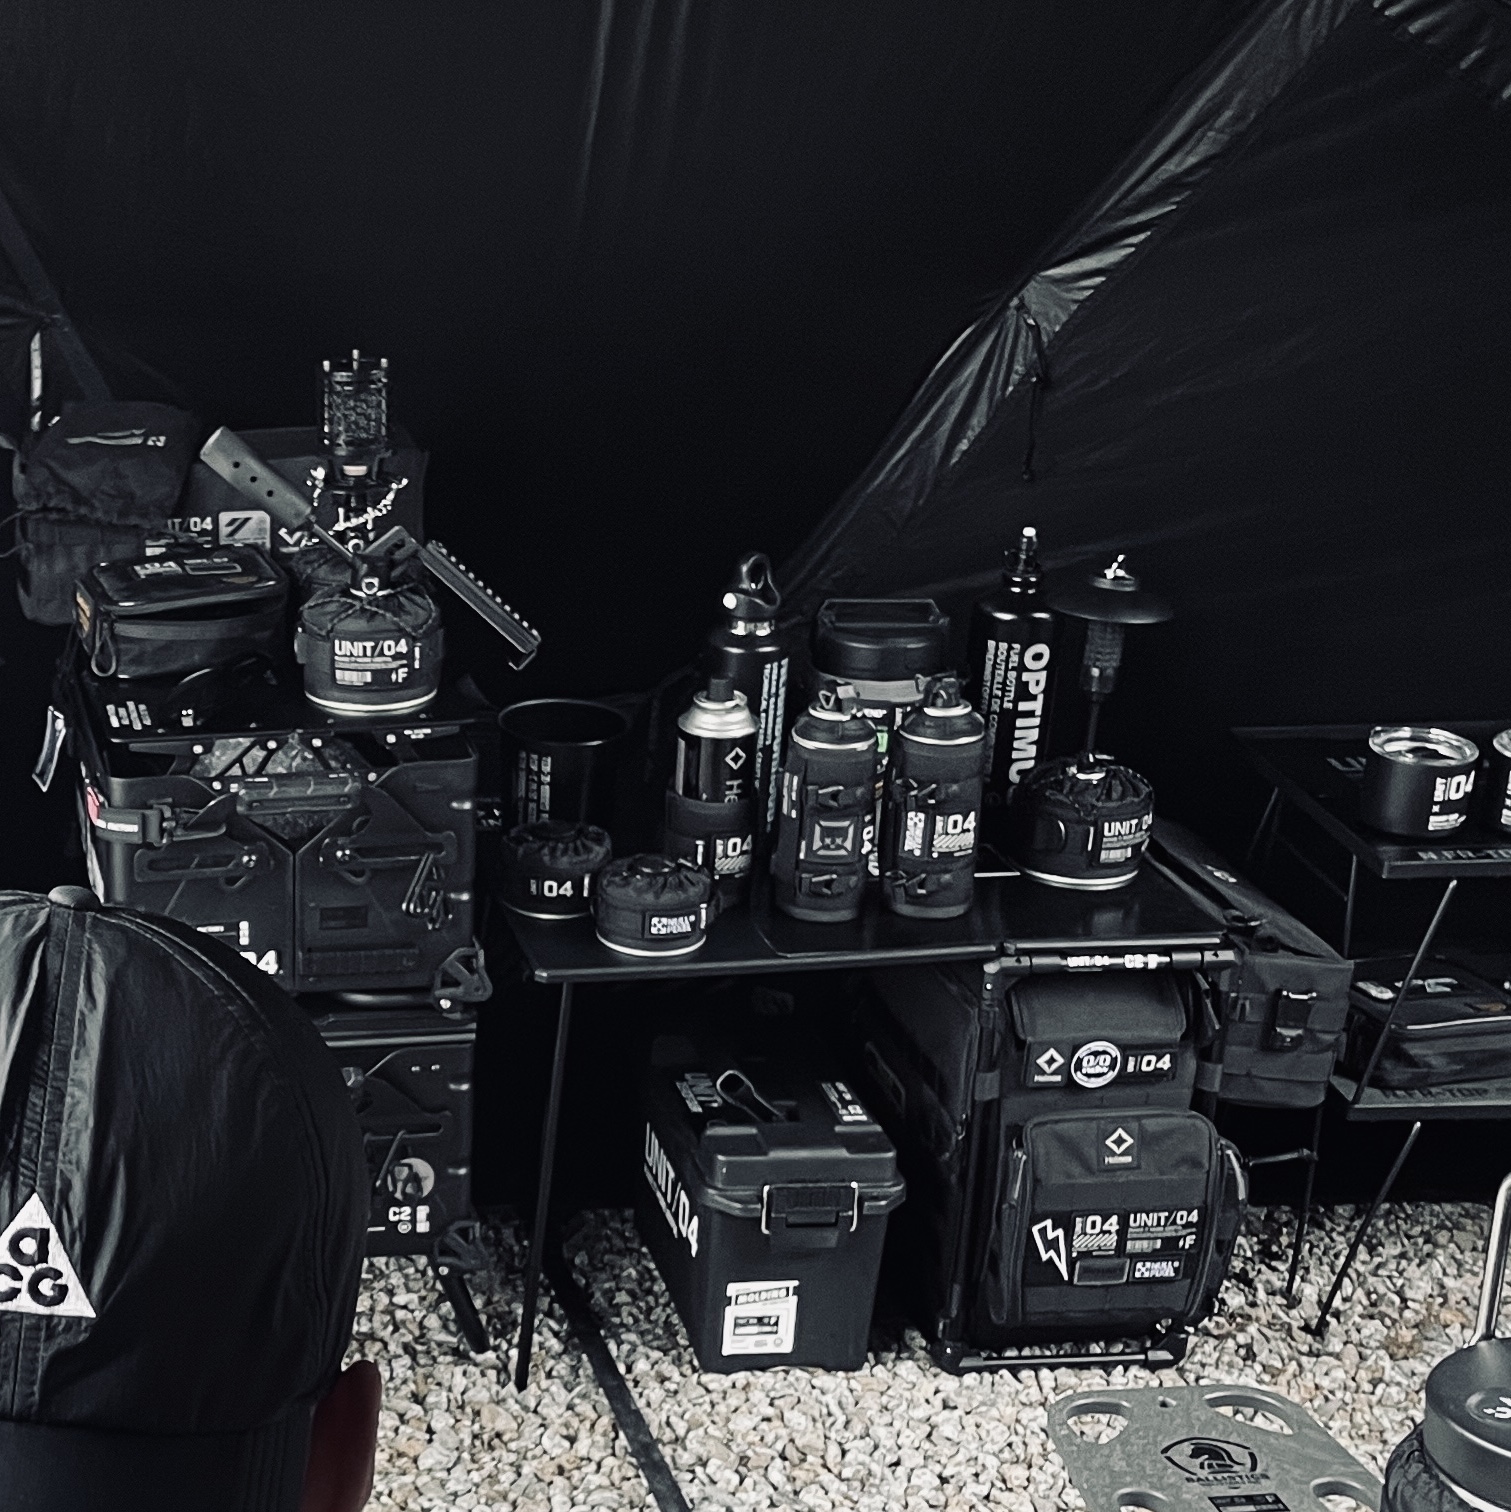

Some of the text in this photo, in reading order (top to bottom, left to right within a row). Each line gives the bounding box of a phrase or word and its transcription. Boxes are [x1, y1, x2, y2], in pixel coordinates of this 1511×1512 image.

[334, 638, 408, 657] UNIT/04
[1007, 643, 1050, 784] OPTIMU
[543, 879, 574, 898] 04
[1140, 1053, 1172, 1072] 04
[644, 1121, 700, 1258] UNIT/04
[387, 1205, 412, 1222] C2
[1129, 1209, 1199, 1227] UNIT/04
[1085, 1214, 1120, 1234] 04
